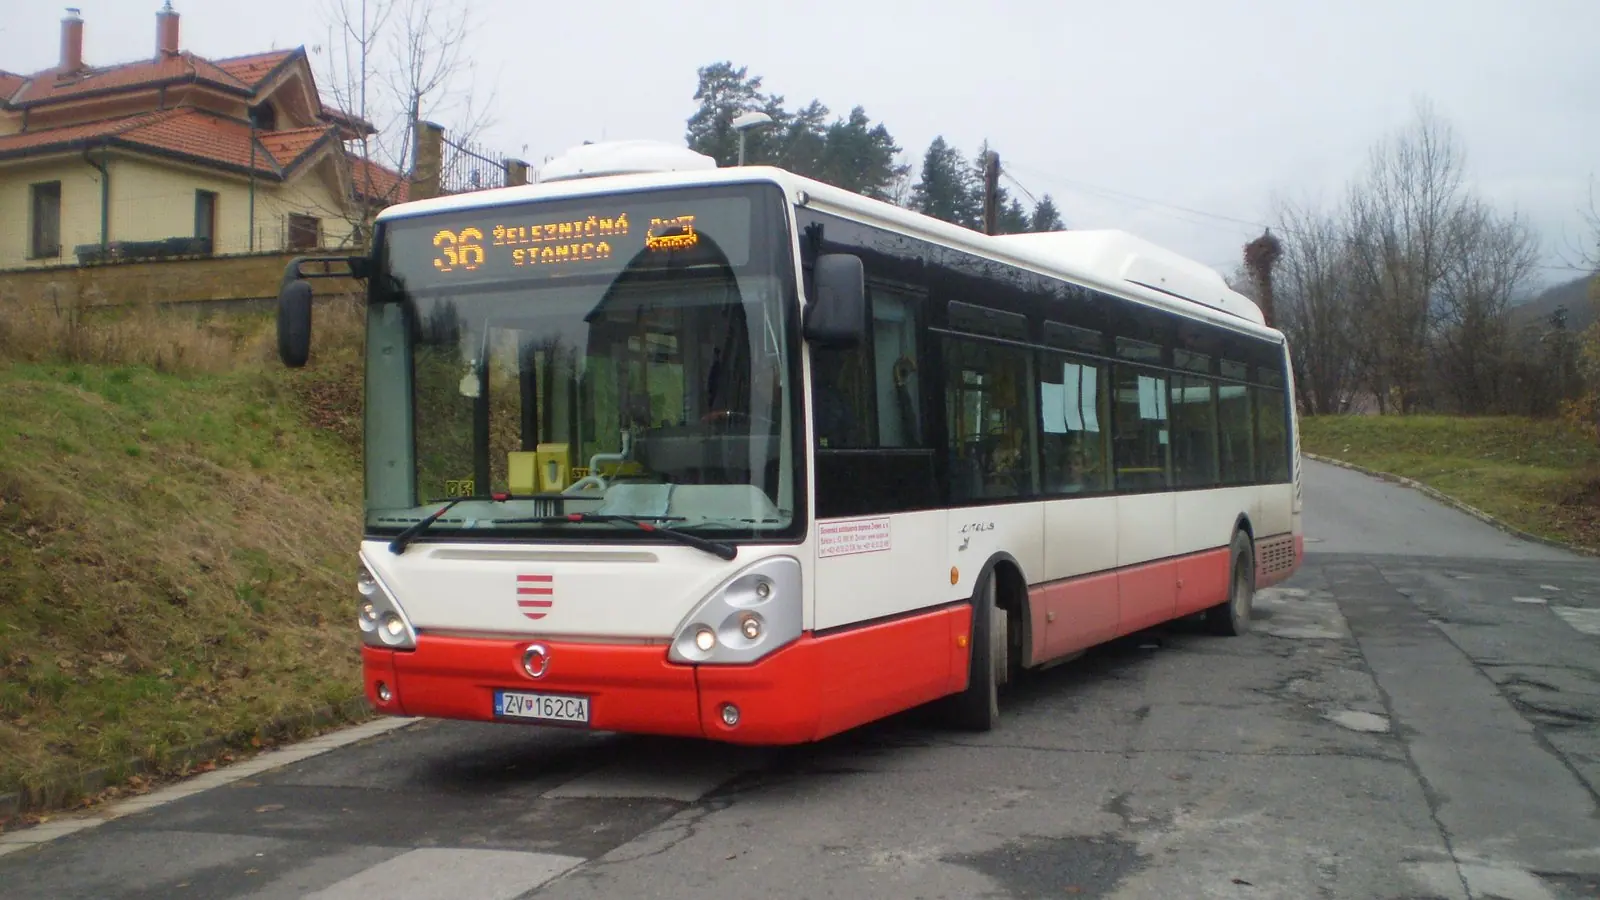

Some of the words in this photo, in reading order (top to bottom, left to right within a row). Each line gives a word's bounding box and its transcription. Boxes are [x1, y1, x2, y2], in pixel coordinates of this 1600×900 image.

[492, 212, 629, 245] ŽELEZNIČNÁ
[432, 226, 484, 272] 36
[512, 241, 611, 266] STANICA
[504, 694, 524, 714] ZV
[536, 697, 585, 720] 162CA
